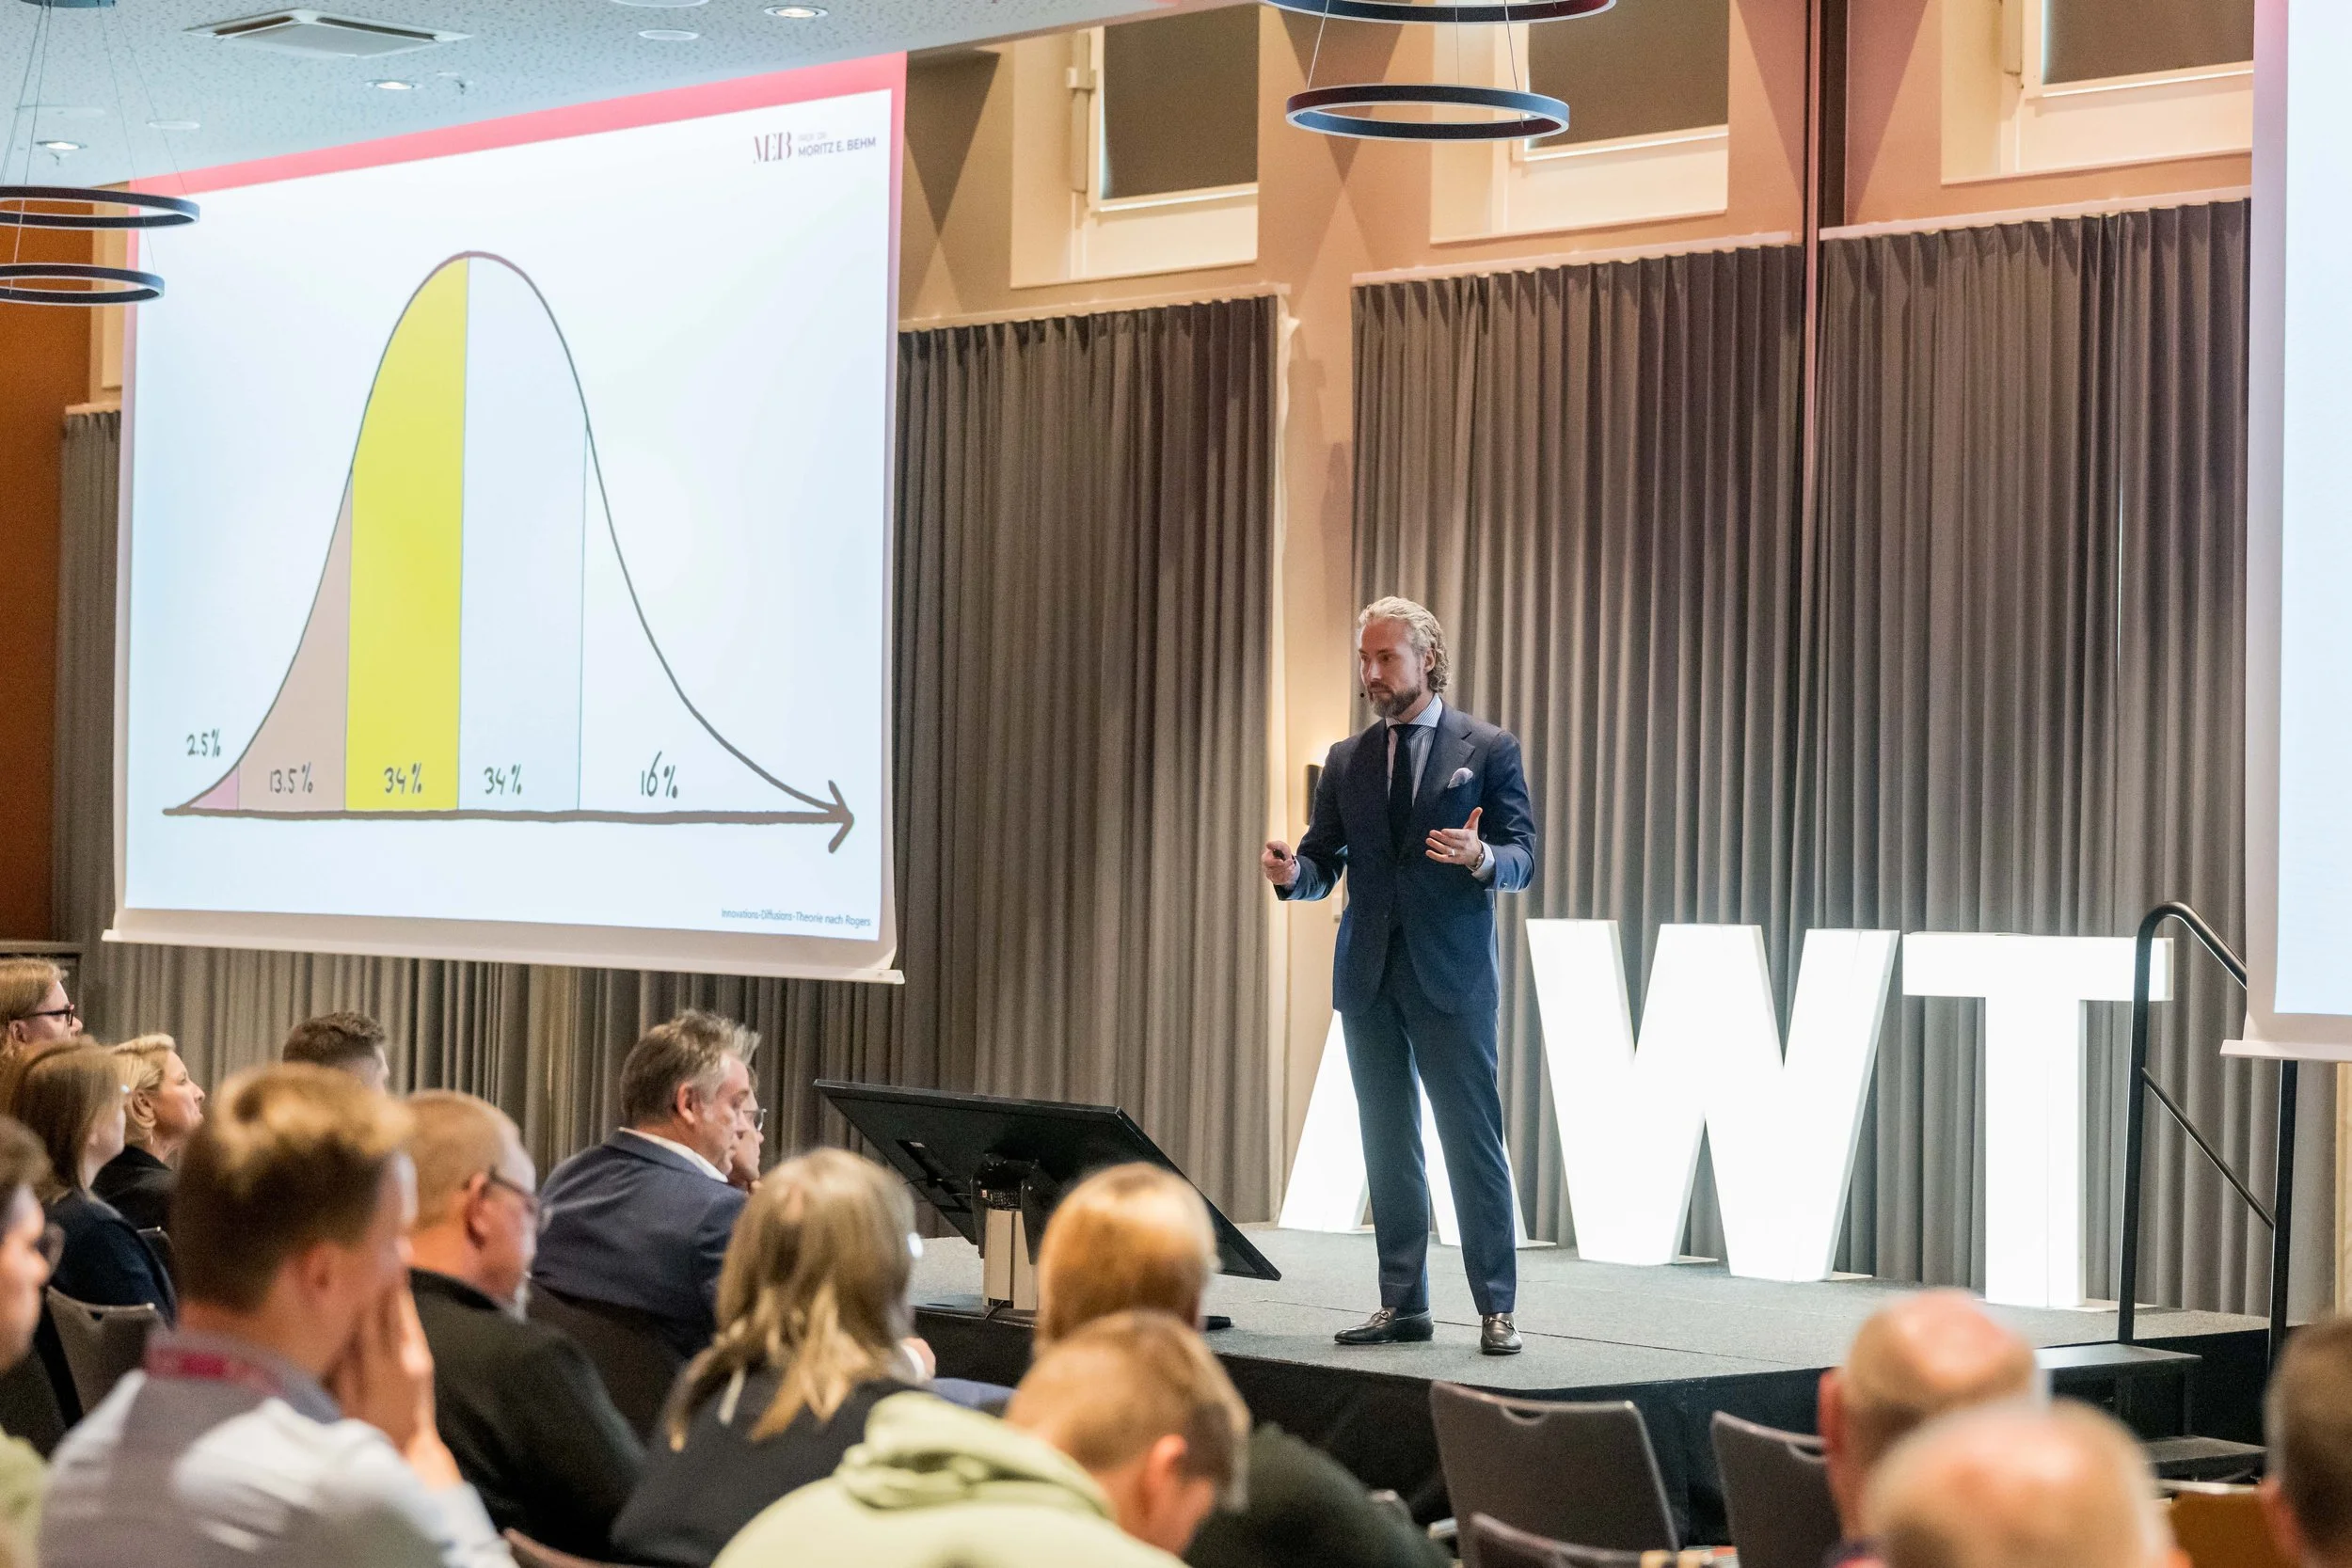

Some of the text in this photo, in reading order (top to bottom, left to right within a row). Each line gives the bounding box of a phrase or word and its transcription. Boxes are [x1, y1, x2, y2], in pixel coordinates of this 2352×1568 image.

[798, 142, 834, 157] MORITZ
[847, 136, 876, 151] BEHM
[186, 728, 221, 757] 2.5%
[384, 763, 422, 795] 34%
[484, 763, 522, 795] 34%
[641, 751, 678, 799] 16%
[825, 914, 844, 925] nach
[846, 915, 871, 928] Rogers
